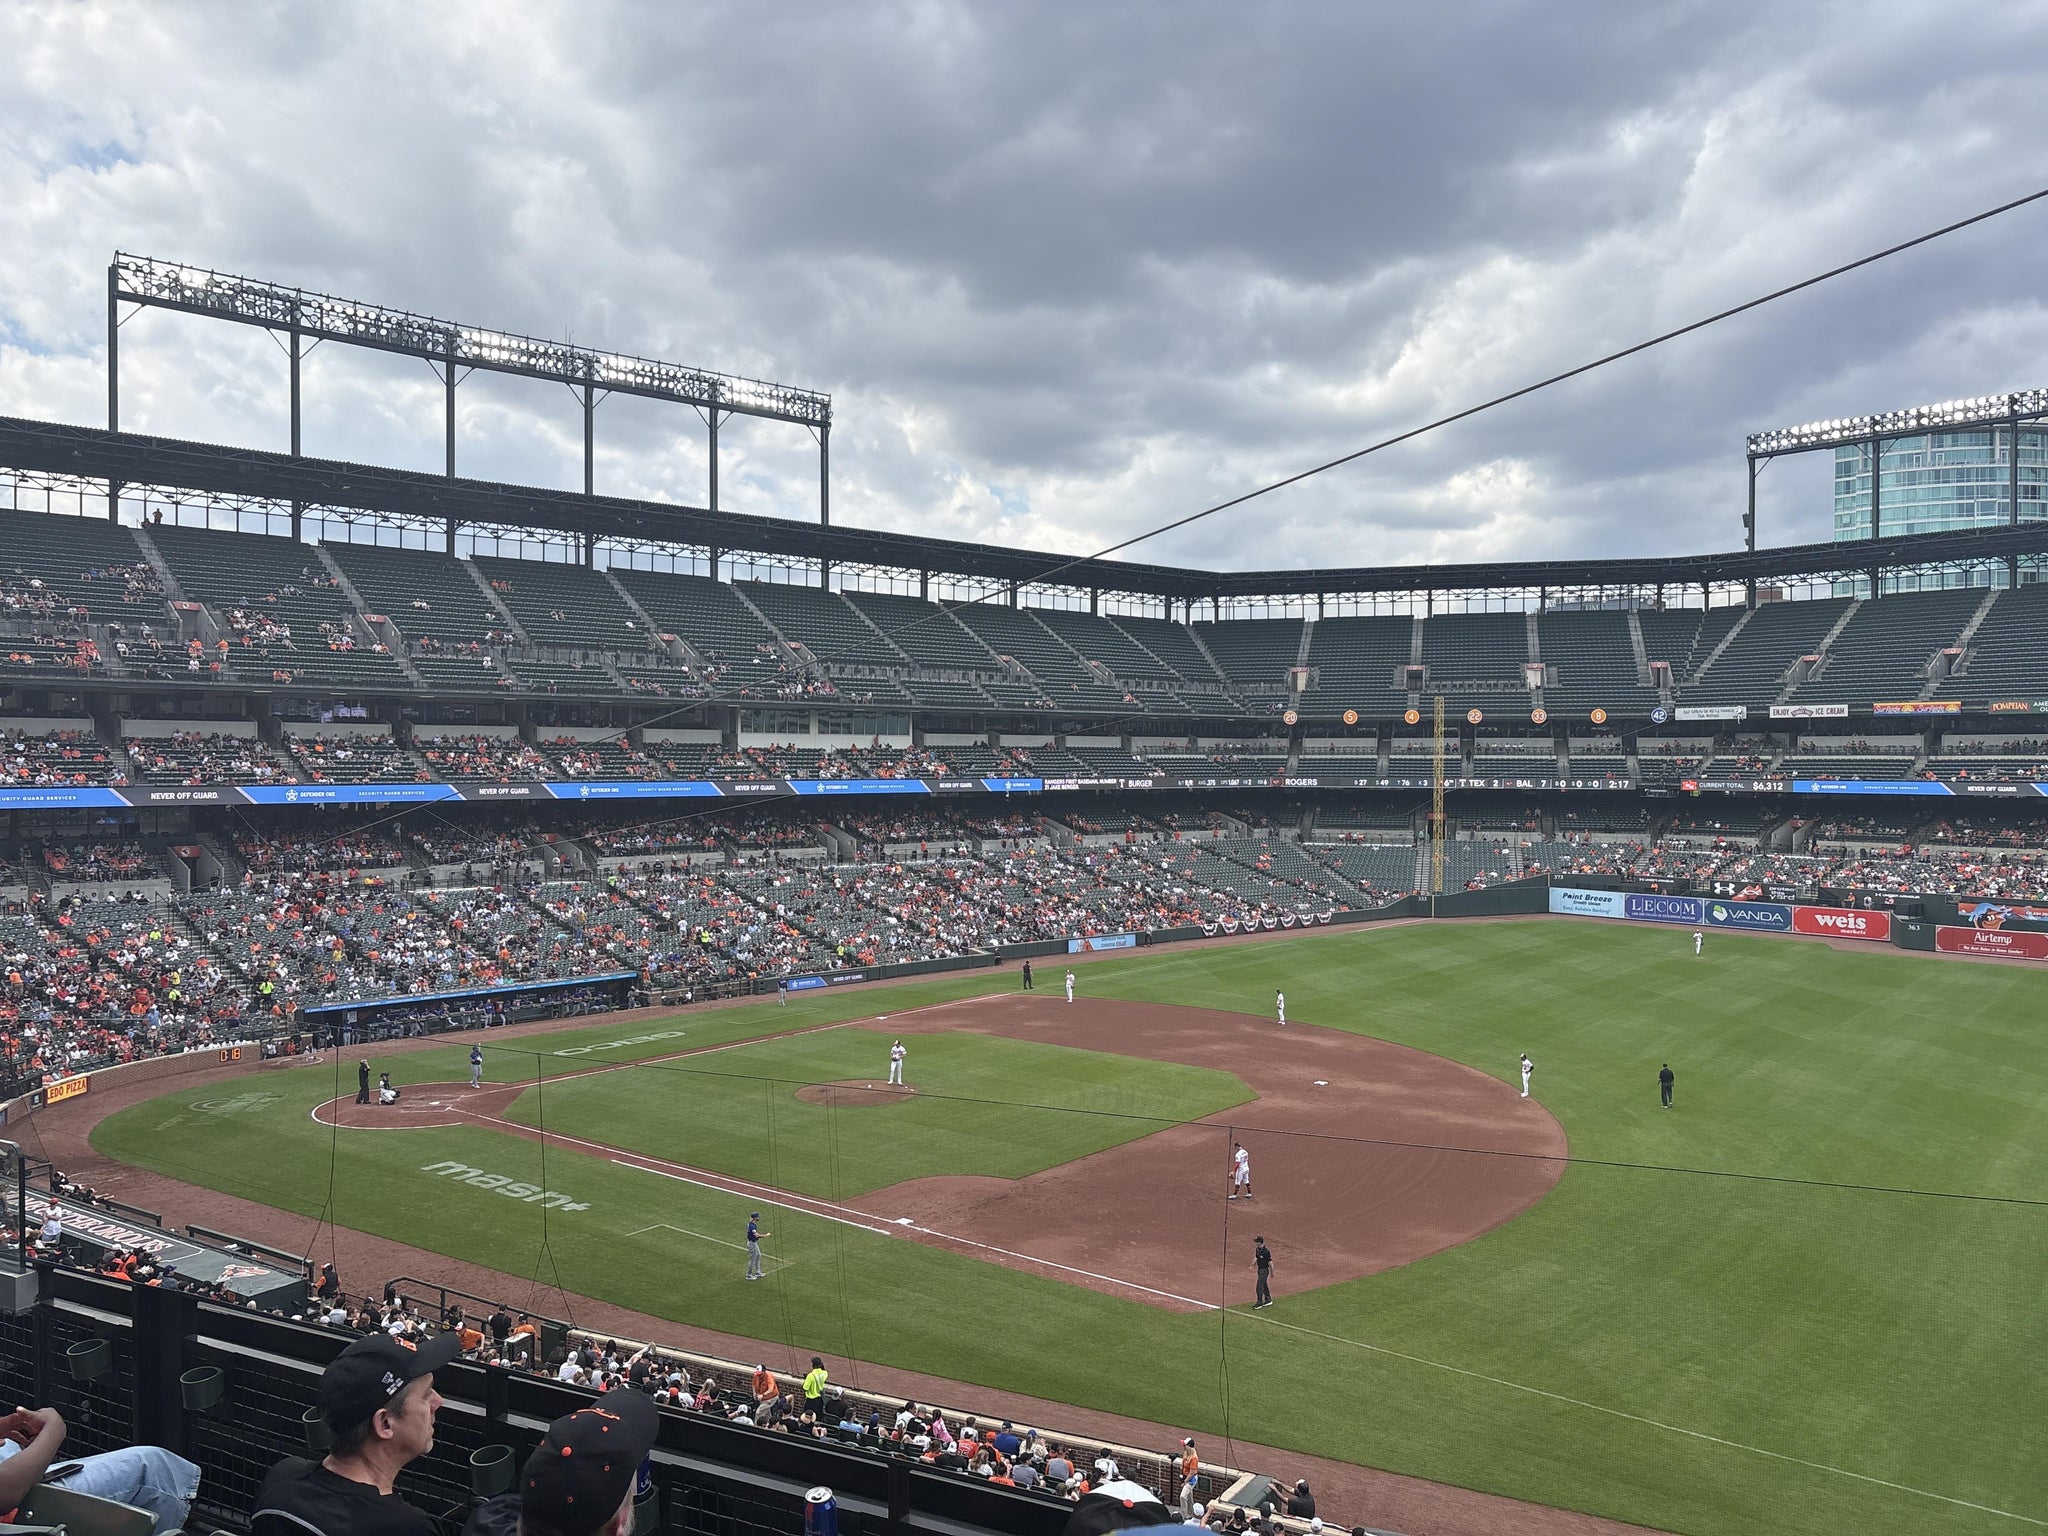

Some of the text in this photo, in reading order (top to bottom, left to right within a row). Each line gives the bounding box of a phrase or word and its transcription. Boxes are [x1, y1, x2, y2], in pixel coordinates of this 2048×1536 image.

[1773, 708, 1790, 716] ENJOY
[1826, 707, 1845, 715] CREAM
[1992, 702, 2028, 712] POMPEIAN
[1285, 714, 1296, 722] 20
[1534, 712, 1544, 720] 33
[1653, 712, 1665, 720] 42
[1608, 780, 1629, 788] 2:17
[1753, 781, 1783, 791] $6,312
[1585, 894, 1612, 903] Breeze
[1632, 899, 1696, 915] LECOM
[1728, 909, 1784, 922] VANDA
[1814, 913, 1866, 929] weis
[1974, 932, 2012, 946] Airtemp
[552, 1031, 686, 1057] GEICO
[48, 1079, 86, 1099] EDO PIZZA
[60, 1211, 105, 1230] THE
[85, 1220, 175, 1254] ORIOLES
